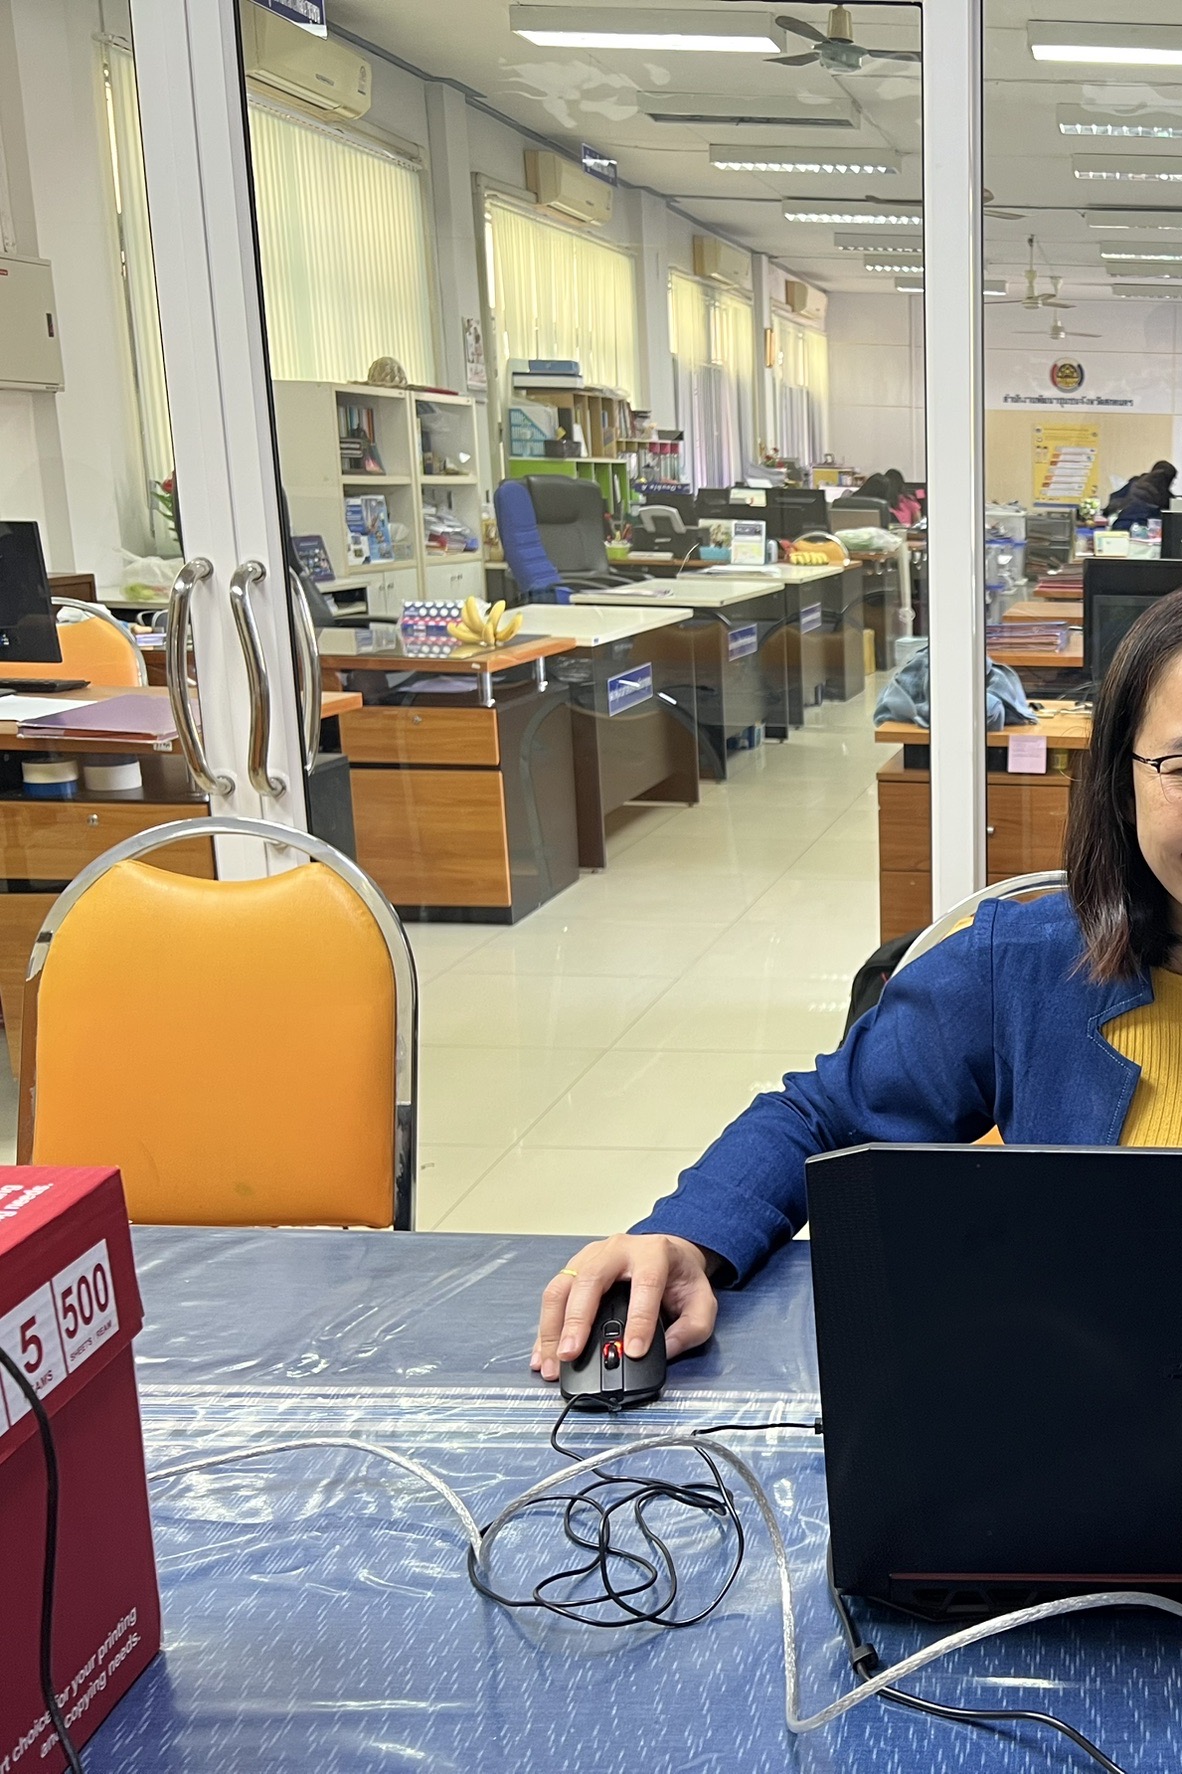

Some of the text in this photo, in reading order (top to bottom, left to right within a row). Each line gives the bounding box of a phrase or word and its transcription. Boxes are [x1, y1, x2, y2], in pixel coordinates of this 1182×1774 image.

[61, 1262, 109, 1339] 500
[20, 1315, 44, 1374] 5
[70, 1337, 93, 1362] SHEETS
[96, 1319, 112, 1338] REAM
[64, 1670, 107, 1729] copying
[108, 1632, 141, 1676] needs.
[71, 1654, 96, 1697] your
[97, 1606, 137, 1665] printing
